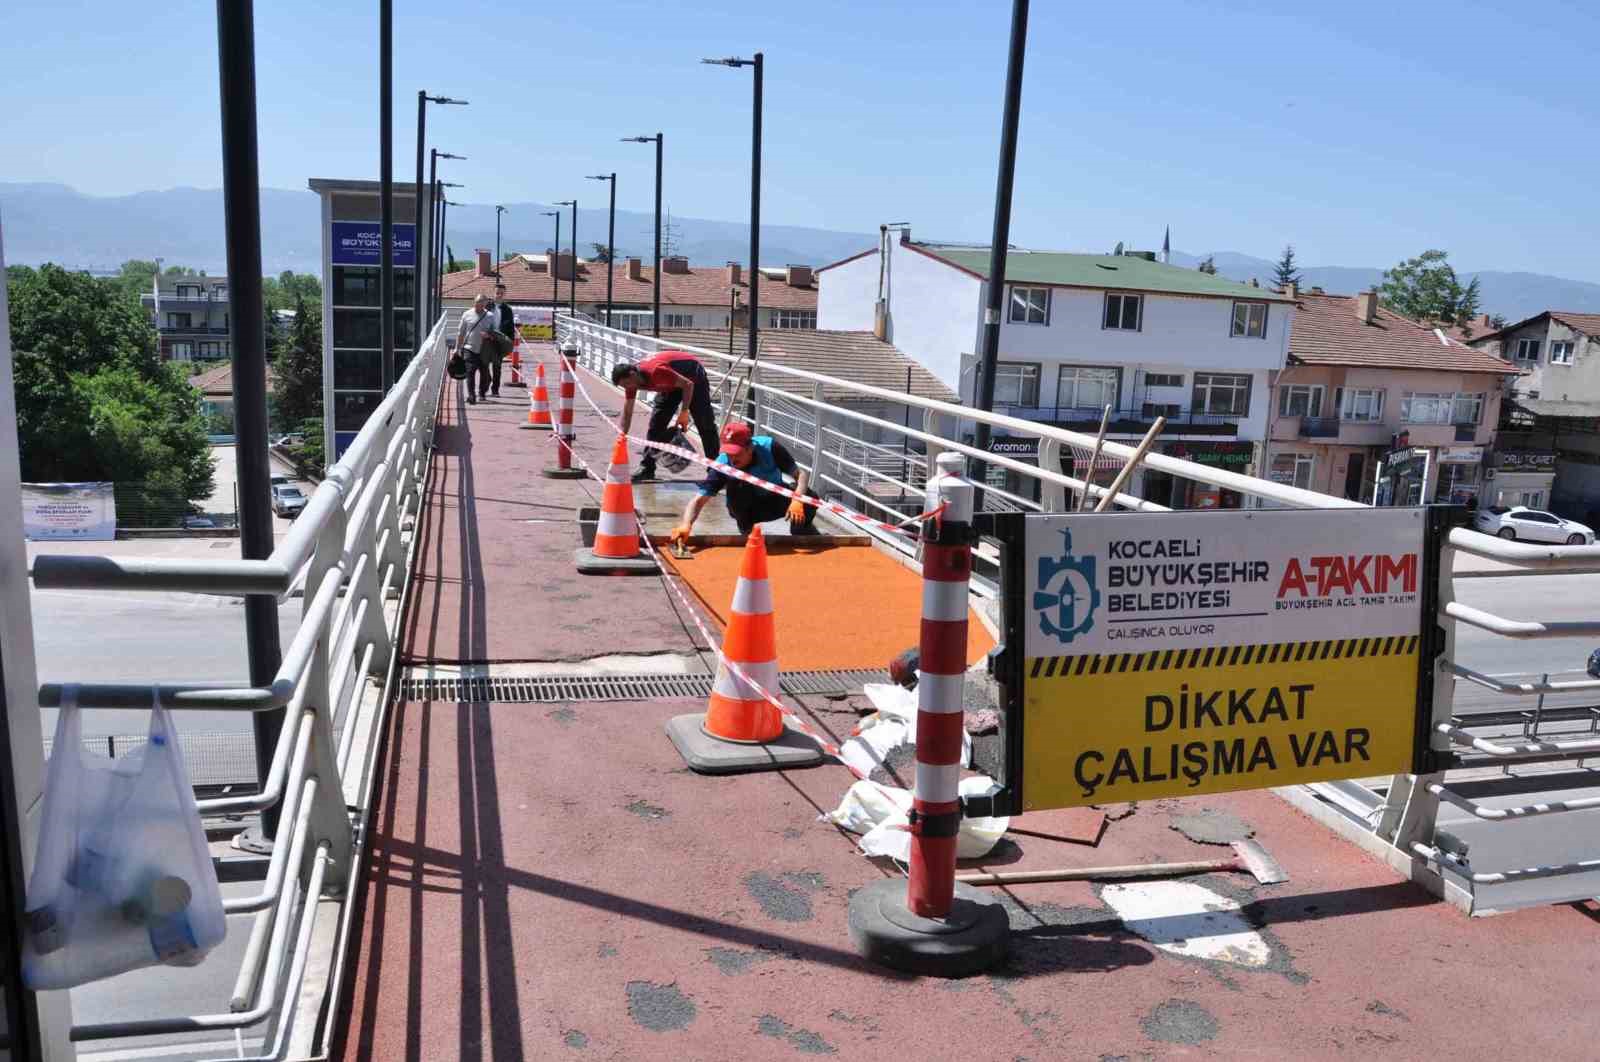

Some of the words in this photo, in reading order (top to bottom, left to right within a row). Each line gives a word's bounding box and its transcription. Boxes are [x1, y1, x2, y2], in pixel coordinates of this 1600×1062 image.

[1108, 539, 1201, 559] KOCAELİ
[1108, 560, 1270, 588] BÜYÜKŞEHİR
[1277, 554, 1418, 598] A-TAKIMI
[1108, 590, 1231, 613] BELEDİYESİ
[1107, 625, 1166, 640] ÇALIŞINCA
[1168, 623, 1216, 637] OLUYOR
[1144, 683, 1316, 733] DİKKAT
[1073, 735, 1278, 798] ÇALIŞMA
[1287, 727, 1372, 769] VAR
